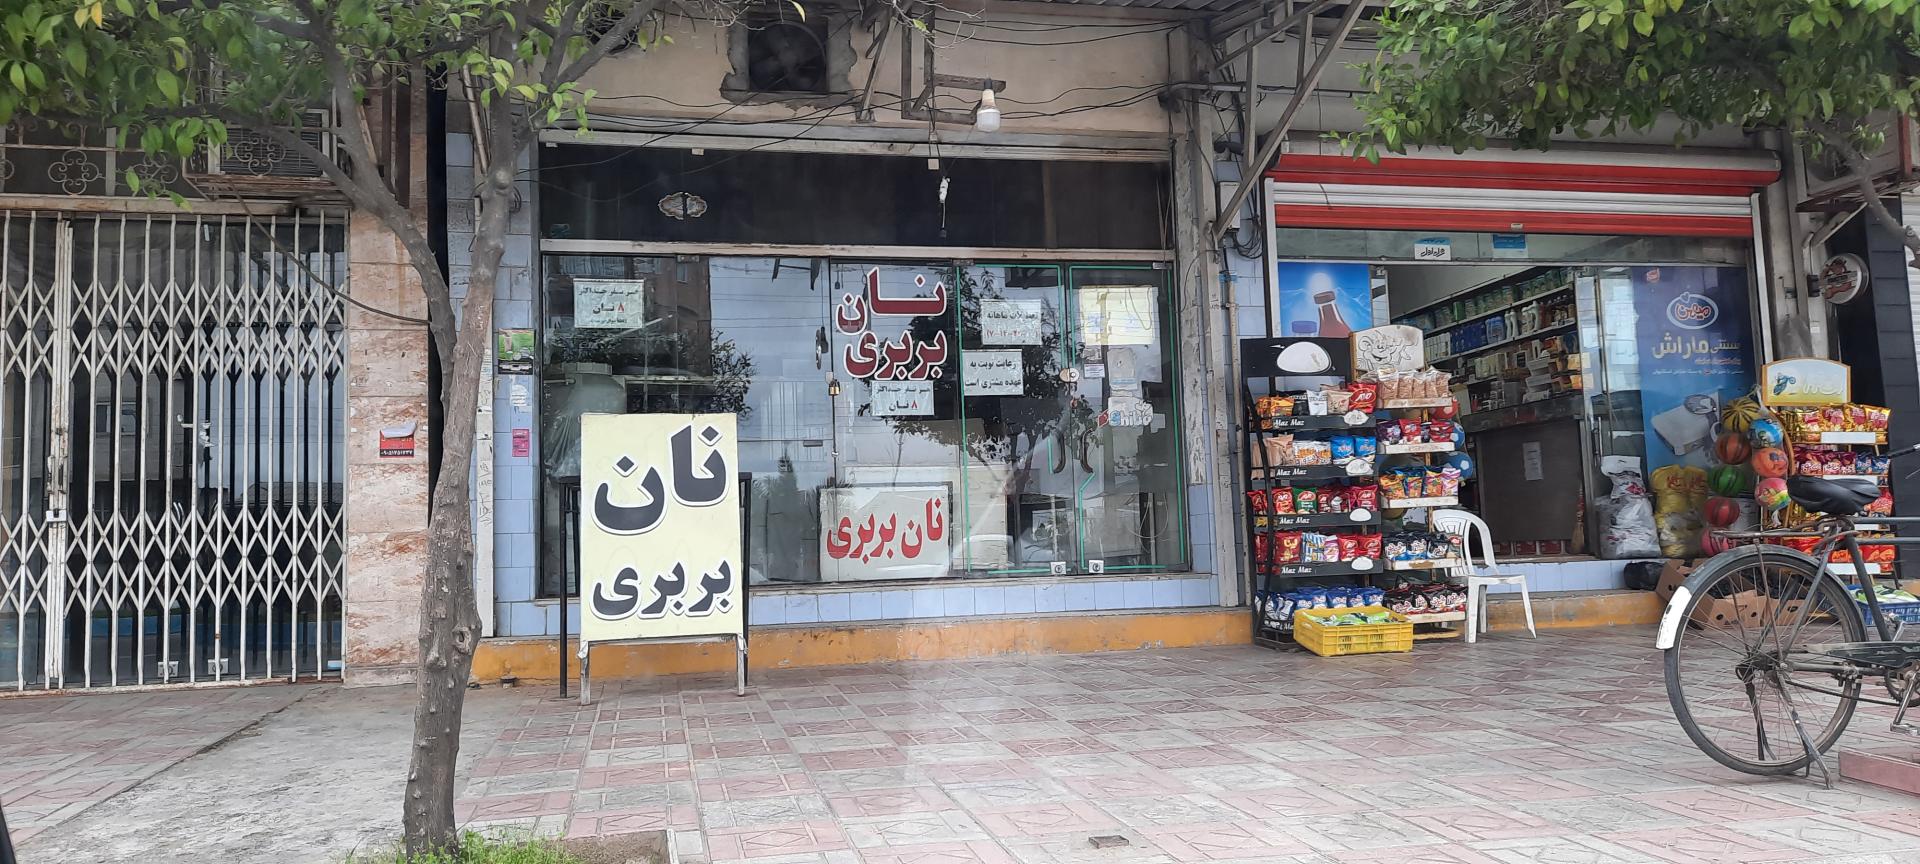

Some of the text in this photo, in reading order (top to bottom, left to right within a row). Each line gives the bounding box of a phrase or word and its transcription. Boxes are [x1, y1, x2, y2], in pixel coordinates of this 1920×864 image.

[836, 266, 947, 335] نان
[592, 302, 625, 314] ۸ نان
[1652, 332, 1709, 359] ماراش
[844, 330, 947, 380] بربری
[969, 358, 1016, 369] رعایت نوبت به
[965, 377, 1021, 389] عهده مشتری است
[889, 400, 918, 411] ۸ نان
[1274, 418, 1305, 427] Maz Maz
[591, 424, 731, 535] نان
[1295, 516, 1310, 524] Maz
[827, 497, 943, 564] نان بربری
[1297, 566, 1312, 574] Maz
[590, 559, 733, 620] بربری
